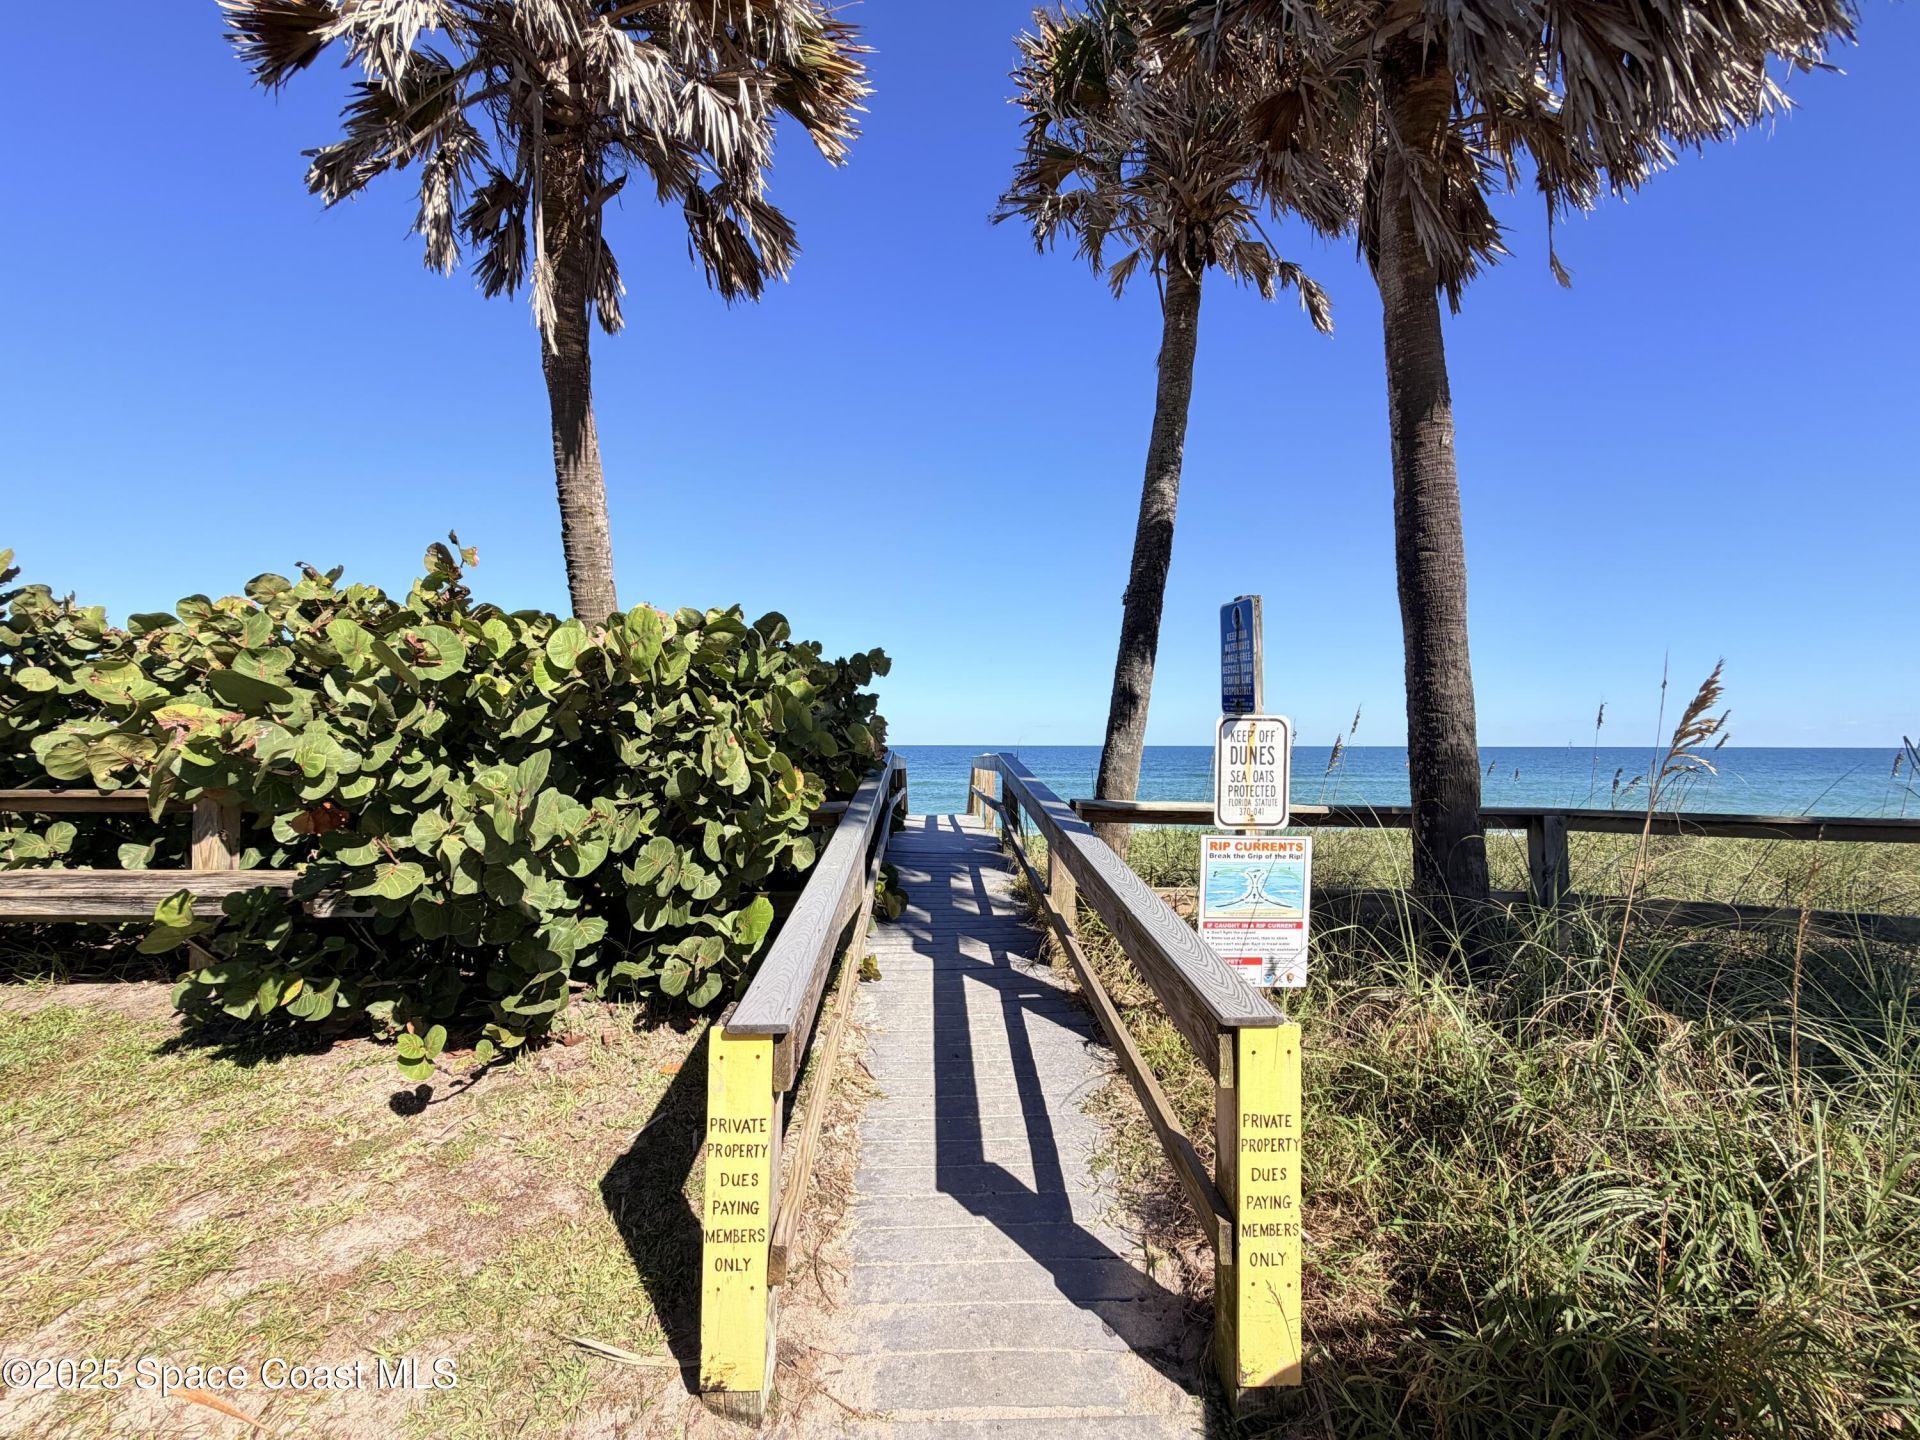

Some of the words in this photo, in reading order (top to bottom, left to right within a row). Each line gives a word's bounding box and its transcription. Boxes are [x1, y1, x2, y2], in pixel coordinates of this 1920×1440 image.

[1230, 730, 1253, 743] KEEP
[1258, 730, 1276, 742] OFF
[1230, 746, 1275, 765] DUNES
[1230, 770, 1248, 783] SEA
[1252, 770, 1275, 783] OATS
[1227, 785, 1276, 797] PROTECTED
[1228, 798, 1251, 807] FLORIDA
[1254, 798, 1278, 807] STATUTE
[1209, 841, 1231, 851] RIP
[1234, 841, 1304, 852] CURRENTS
[1247, 853, 1263, 861] Grip
[1288, 853, 1303, 861] Rip!
[709, 1117, 767, 1134] PRIVATE
[1242, 1113, 1292, 1129] PRIVATE
[706, 1143, 769, 1158] PROPERTY
[1241, 1138, 1301, 1152] PROPERTY
[720, 1172, 759, 1187] DUES
[1251, 1167, 1287, 1182] DUES
[712, 1200, 760, 1215] PAYING
[1246, 1195, 1293, 1210] PAYING
[705, 1228, 766, 1244] MEMBERS
[1241, 1223, 1300, 1238] MEMBERS
[714, 1257, 752, 1272] ONLY
[1249, 1251, 1287, 1267] ONLY
